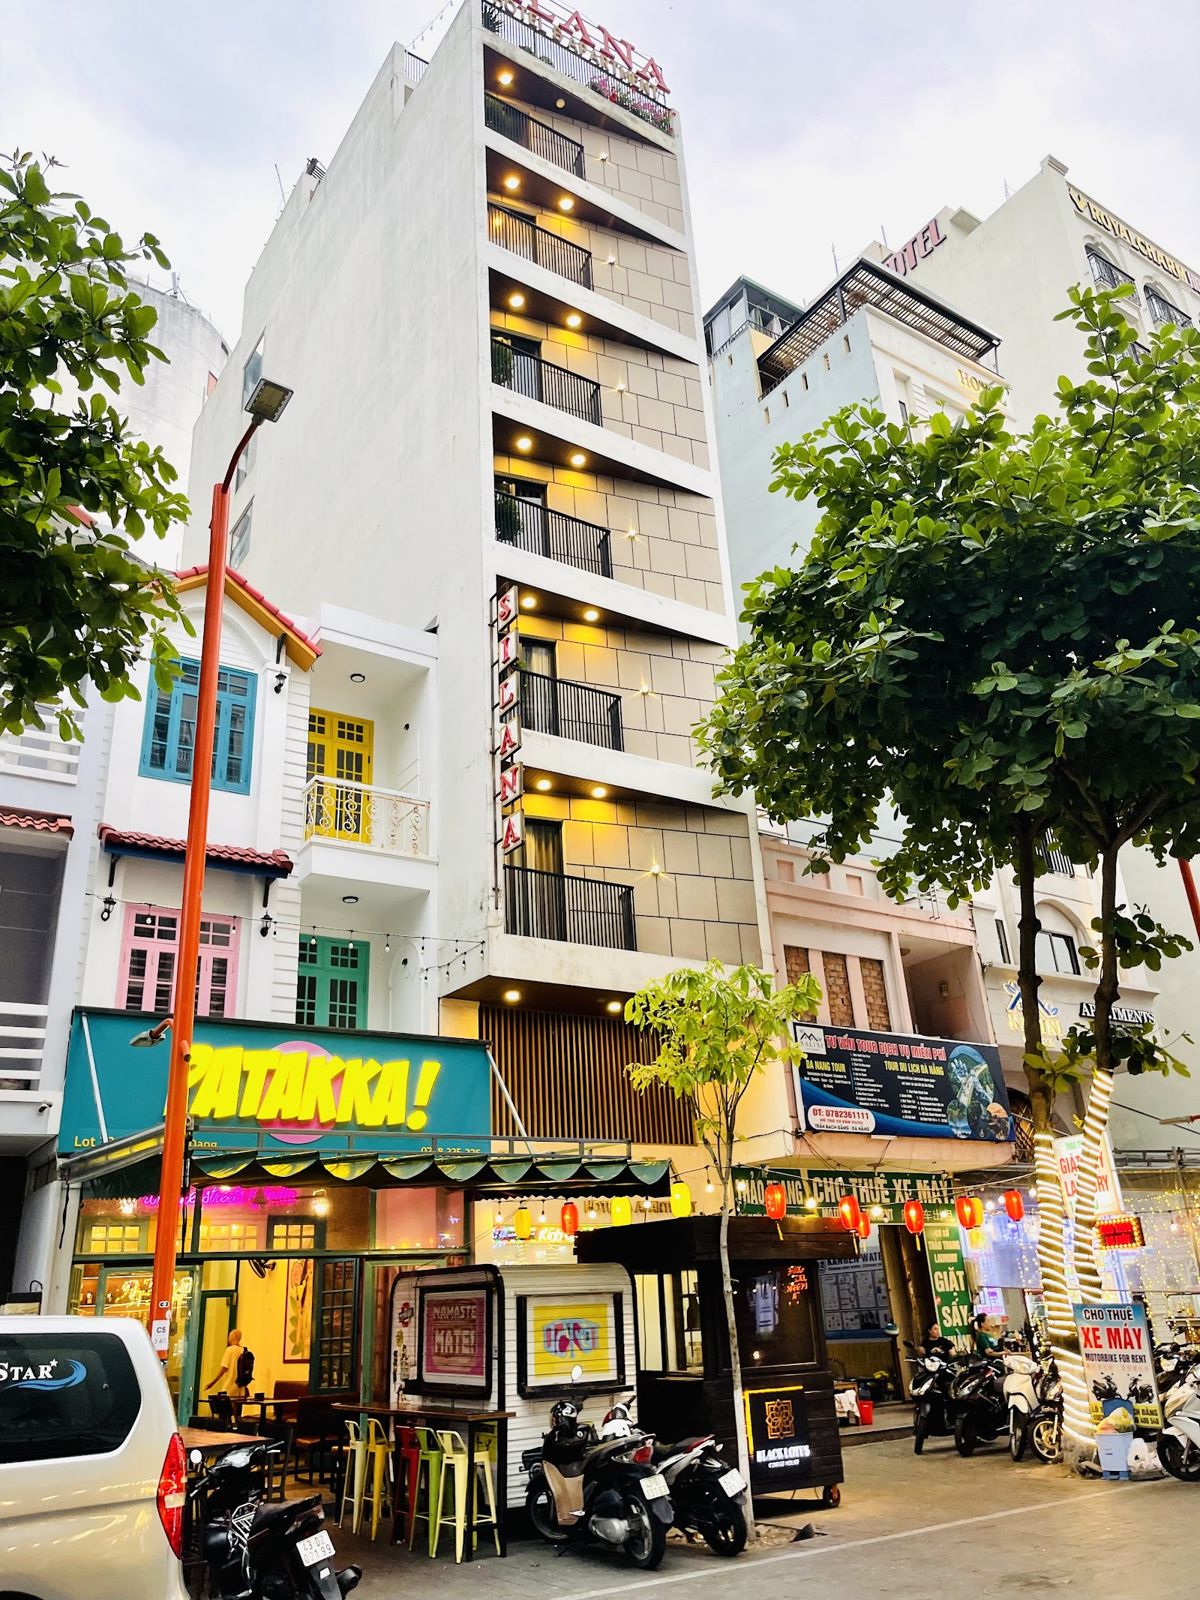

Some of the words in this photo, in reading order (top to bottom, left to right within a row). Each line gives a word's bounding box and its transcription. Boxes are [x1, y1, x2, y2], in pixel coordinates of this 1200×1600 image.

[500, 594, 521, 850] SILANA
[1081, 1002, 1156, 1024] APTMENTS
[856, 1038, 878, 1054] TOUR
[832, 1062, 846, 1073] TOUR
[884, 1060, 899, 1072] TOUR
[164, 1044, 441, 1131] PATAKKA!
[74, 1136, 95, 1147] Lot
[767, 1180, 803, 1205] TANG
[849, 1173, 890, 1203] THUÊ
[1064, 1174, 1110, 1198] LARY
[934, 1266, 966, 1297] GIẶT
[433, 1305, 477, 1320] NAMASTE
[1083, 1309, 1104, 1321] CHO
[1107, 1308, 1133, 1321] THUÊ
[1081, 1326, 1103, 1349] XE
[1107, 1323, 1144, 1350] MÁY
[1085, 1353, 1118, 1362] MOTORBIKE
[1119, 1354, 1131, 1363] FOR
[1131, 1355, 1146, 1364] RENT
